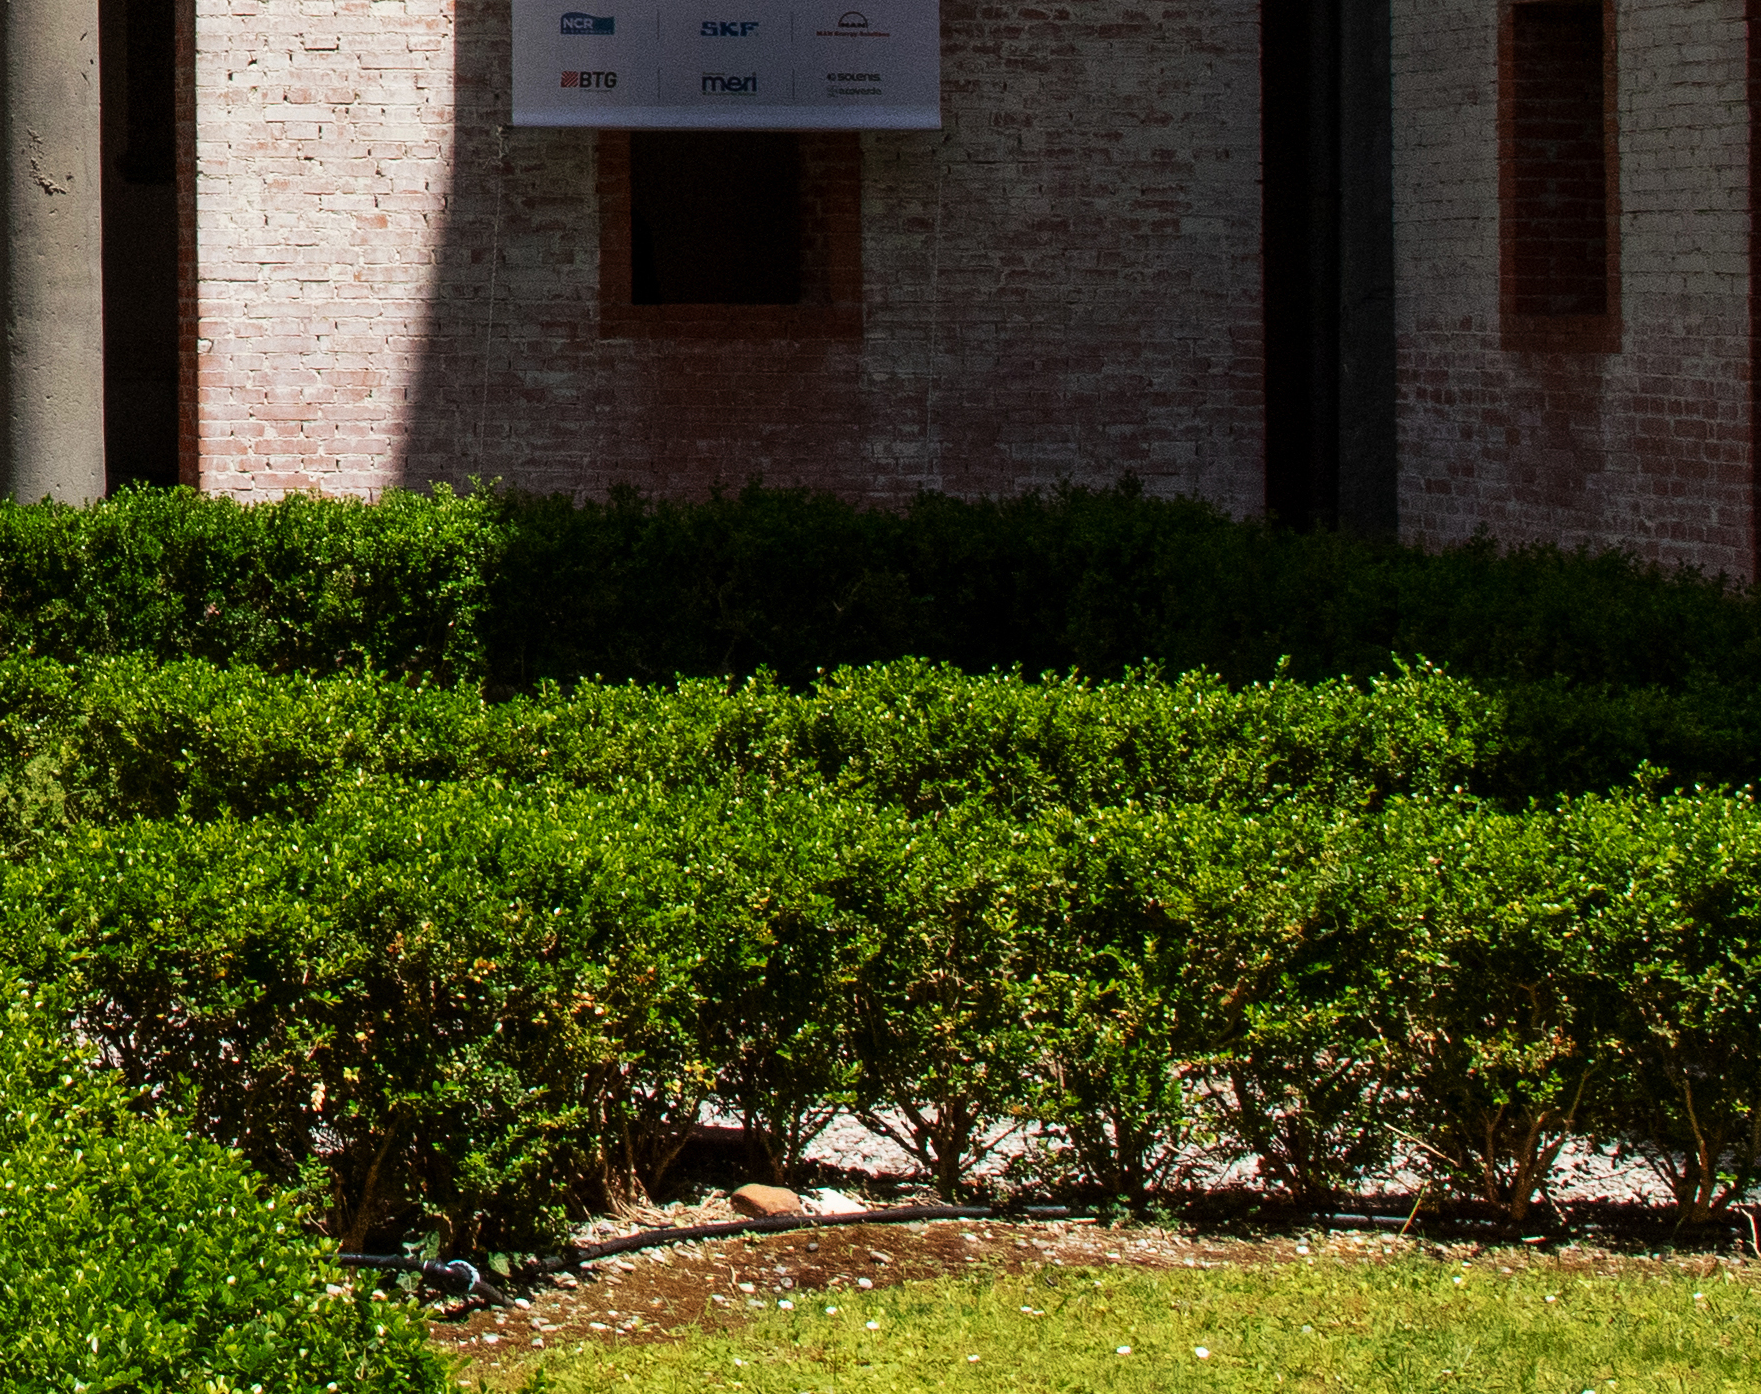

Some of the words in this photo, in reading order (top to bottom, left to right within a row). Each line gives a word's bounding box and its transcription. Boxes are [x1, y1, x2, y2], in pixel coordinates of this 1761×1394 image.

[563, 18, 593, 29] NCR
[701, 21, 759, 36] SKF
[579, 71, 617, 88] BTG
[702, 72, 756, 92] meri
